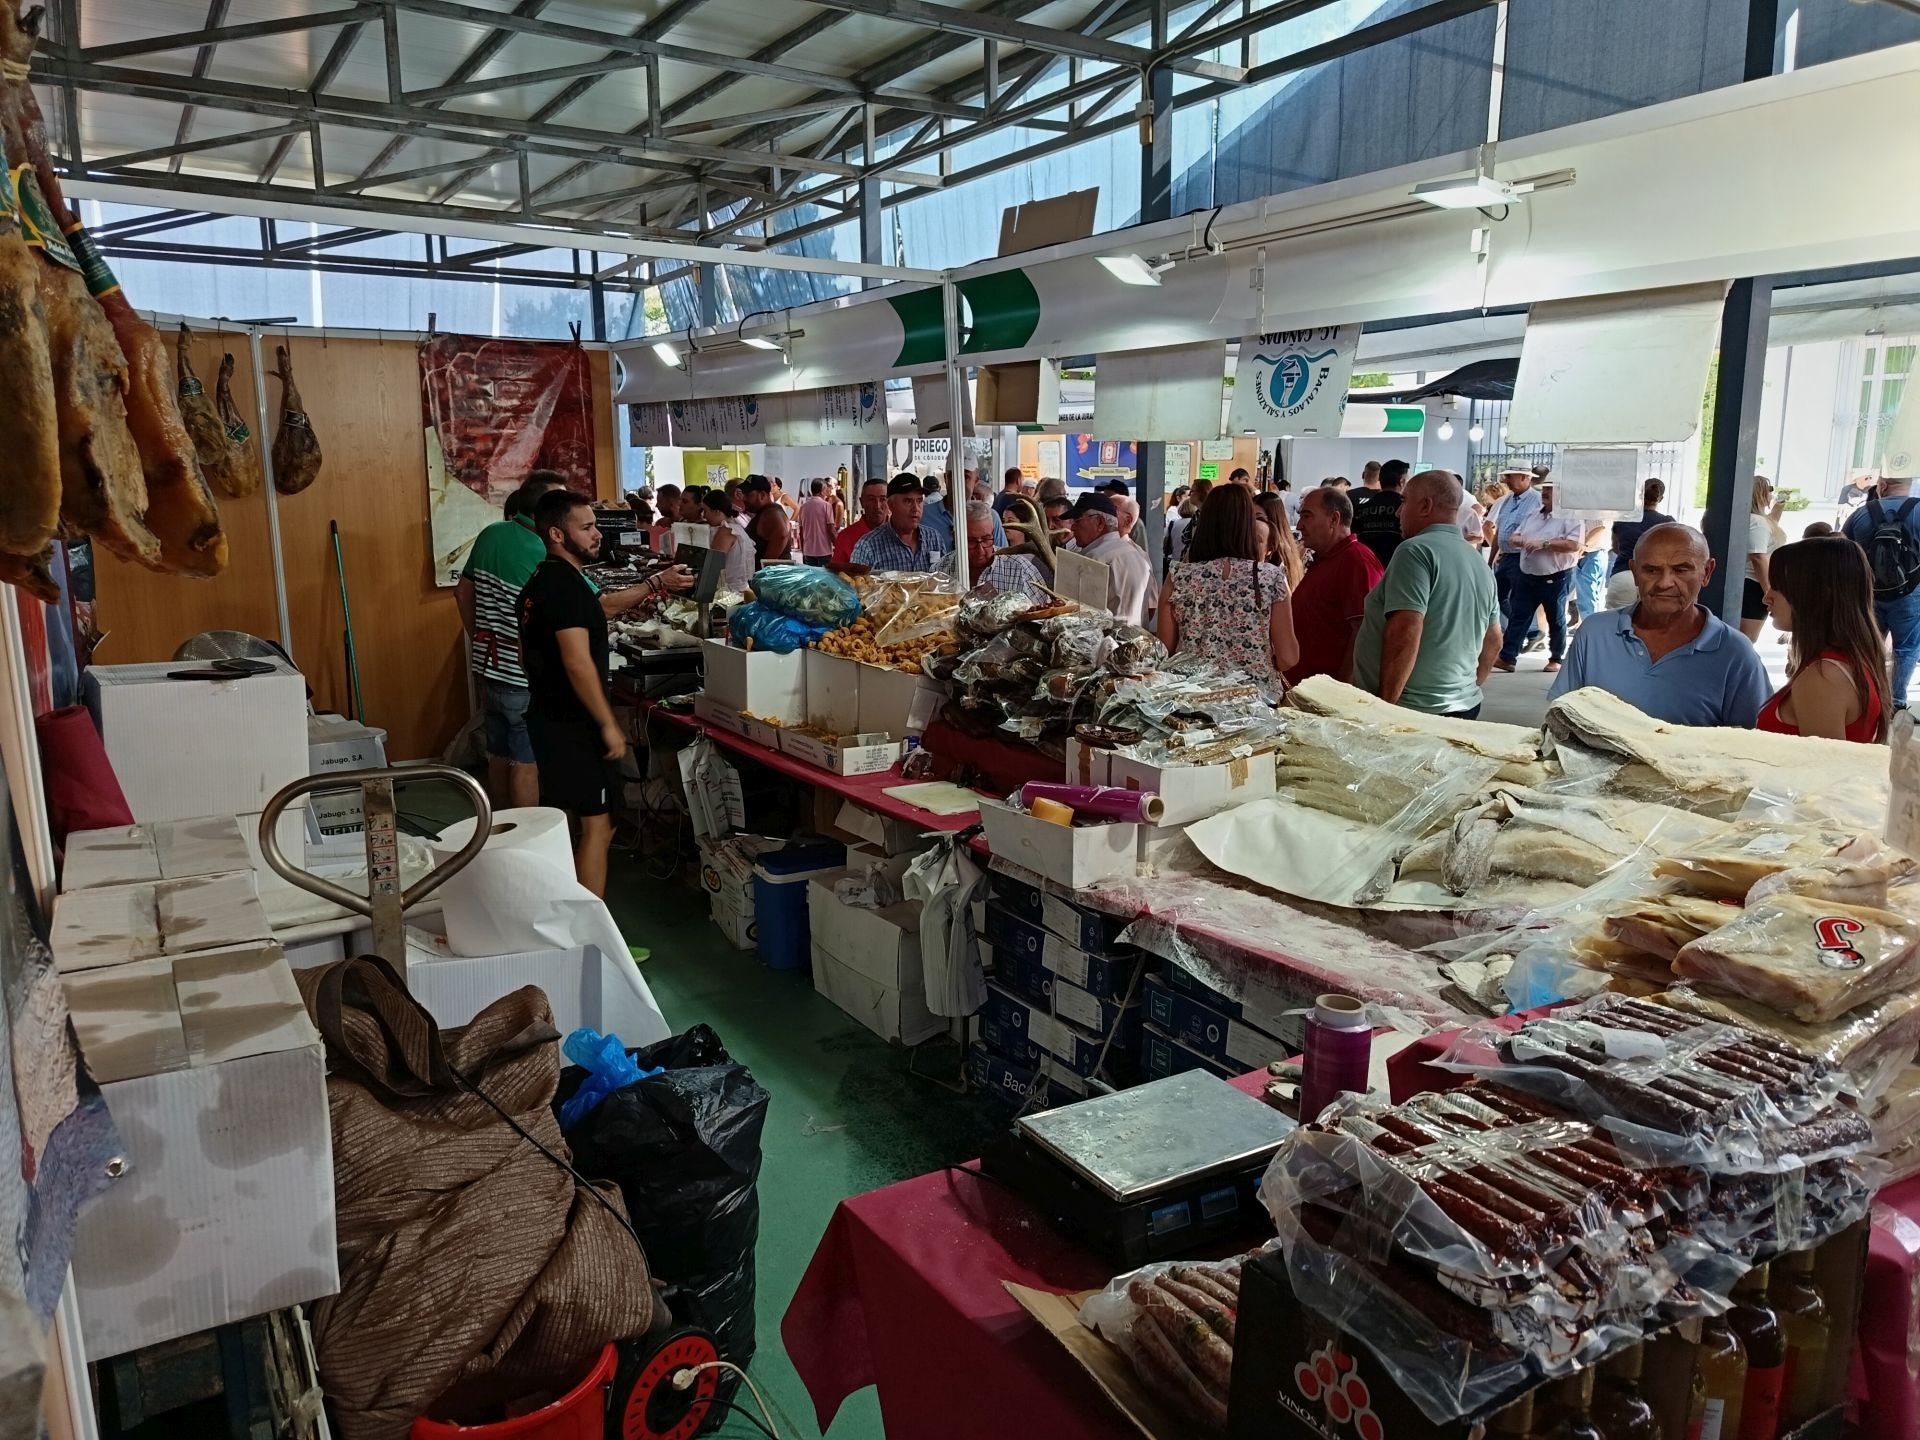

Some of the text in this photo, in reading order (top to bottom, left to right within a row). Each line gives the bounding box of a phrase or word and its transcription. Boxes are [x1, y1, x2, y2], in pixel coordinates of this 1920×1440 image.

[1259, 329, 1313, 346] CAÑADAS
[1255, 370, 1281, 418] SALAZONES
[1288, 367, 1330, 416] BACALAOS
[914, 440, 948, 452] PRIEGO
[320, 756, 351, 766] Jabugo,
[1003, 1071, 1049, 1107] Bacalao
[1278, 1390, 1318, 1426] VINOS
